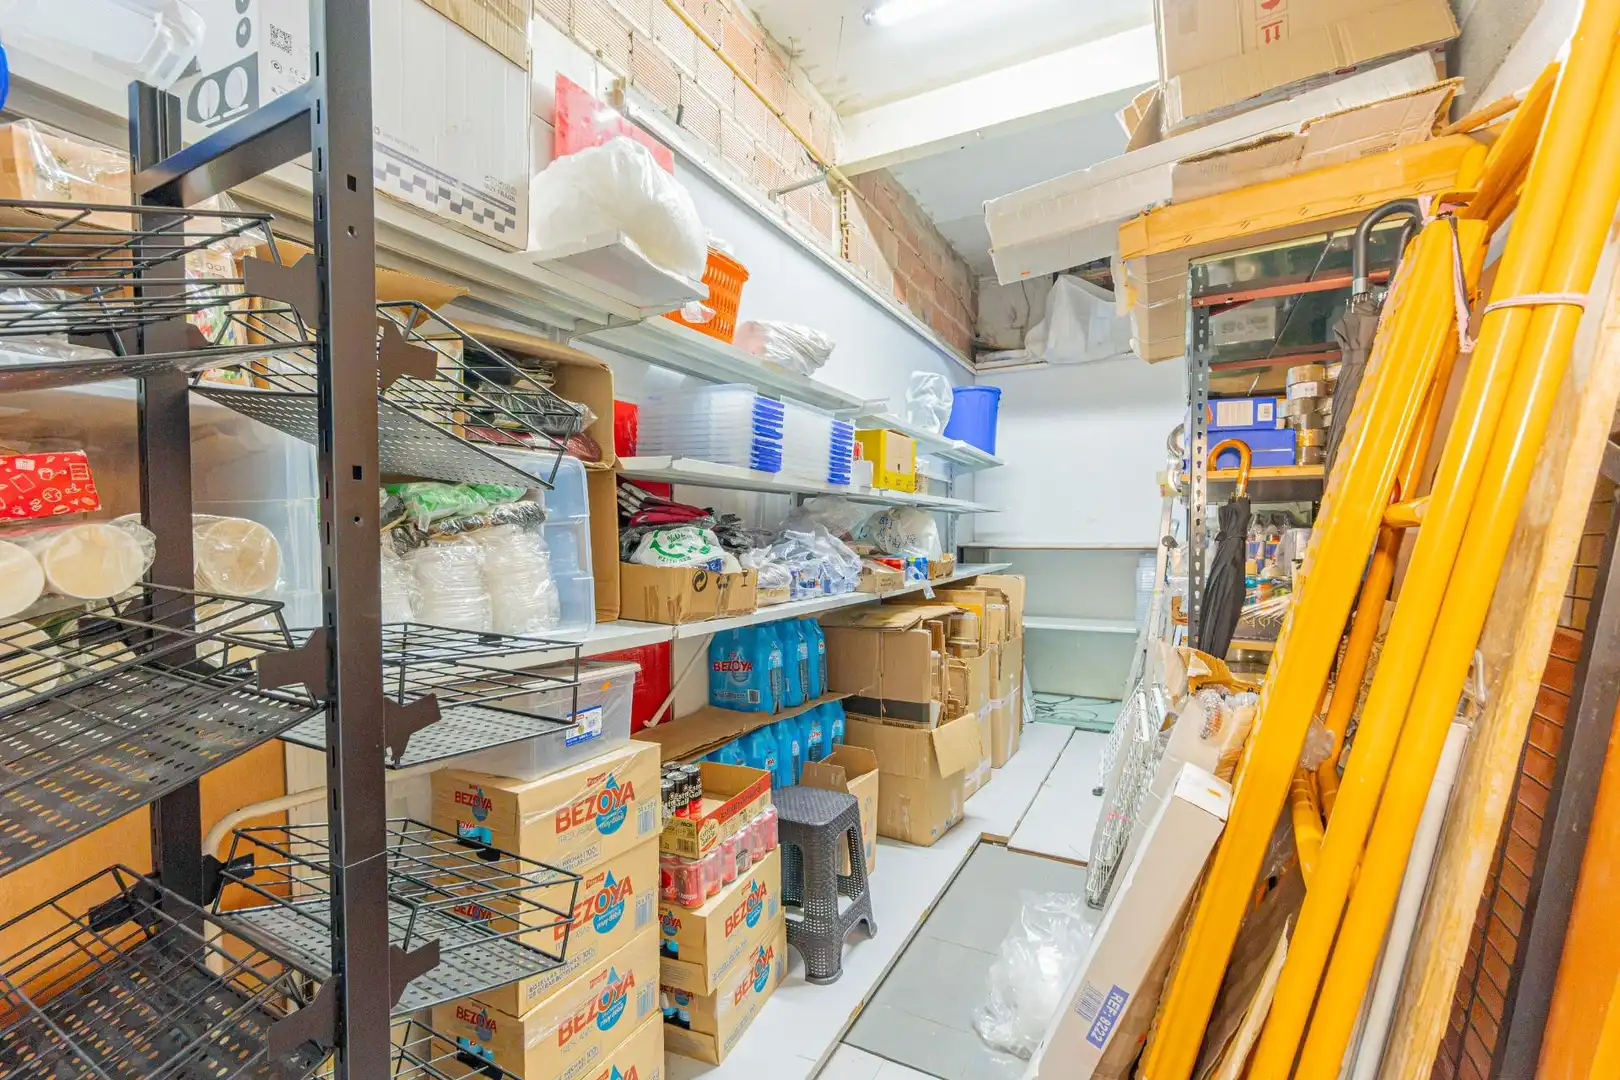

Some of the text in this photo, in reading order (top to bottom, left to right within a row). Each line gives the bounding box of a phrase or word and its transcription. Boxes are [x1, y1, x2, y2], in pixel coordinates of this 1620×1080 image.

[713, 660, 753, 672] BEZOYA
[454, 790, 493, 812] BEZOYA
[555, 780, 636, 834] BEZOYA
[554, 876, 633, 941] BEZOYA
[725, 881, 767, 938] BEZOYA
[734, 944, 775, 1006] BEZOYA
[455, 1005, 498, 1034] BEZOYA
[558, 968, 636, 1048] BEZOYA
[1090, 991, 1125, 1043] REF: 8222
